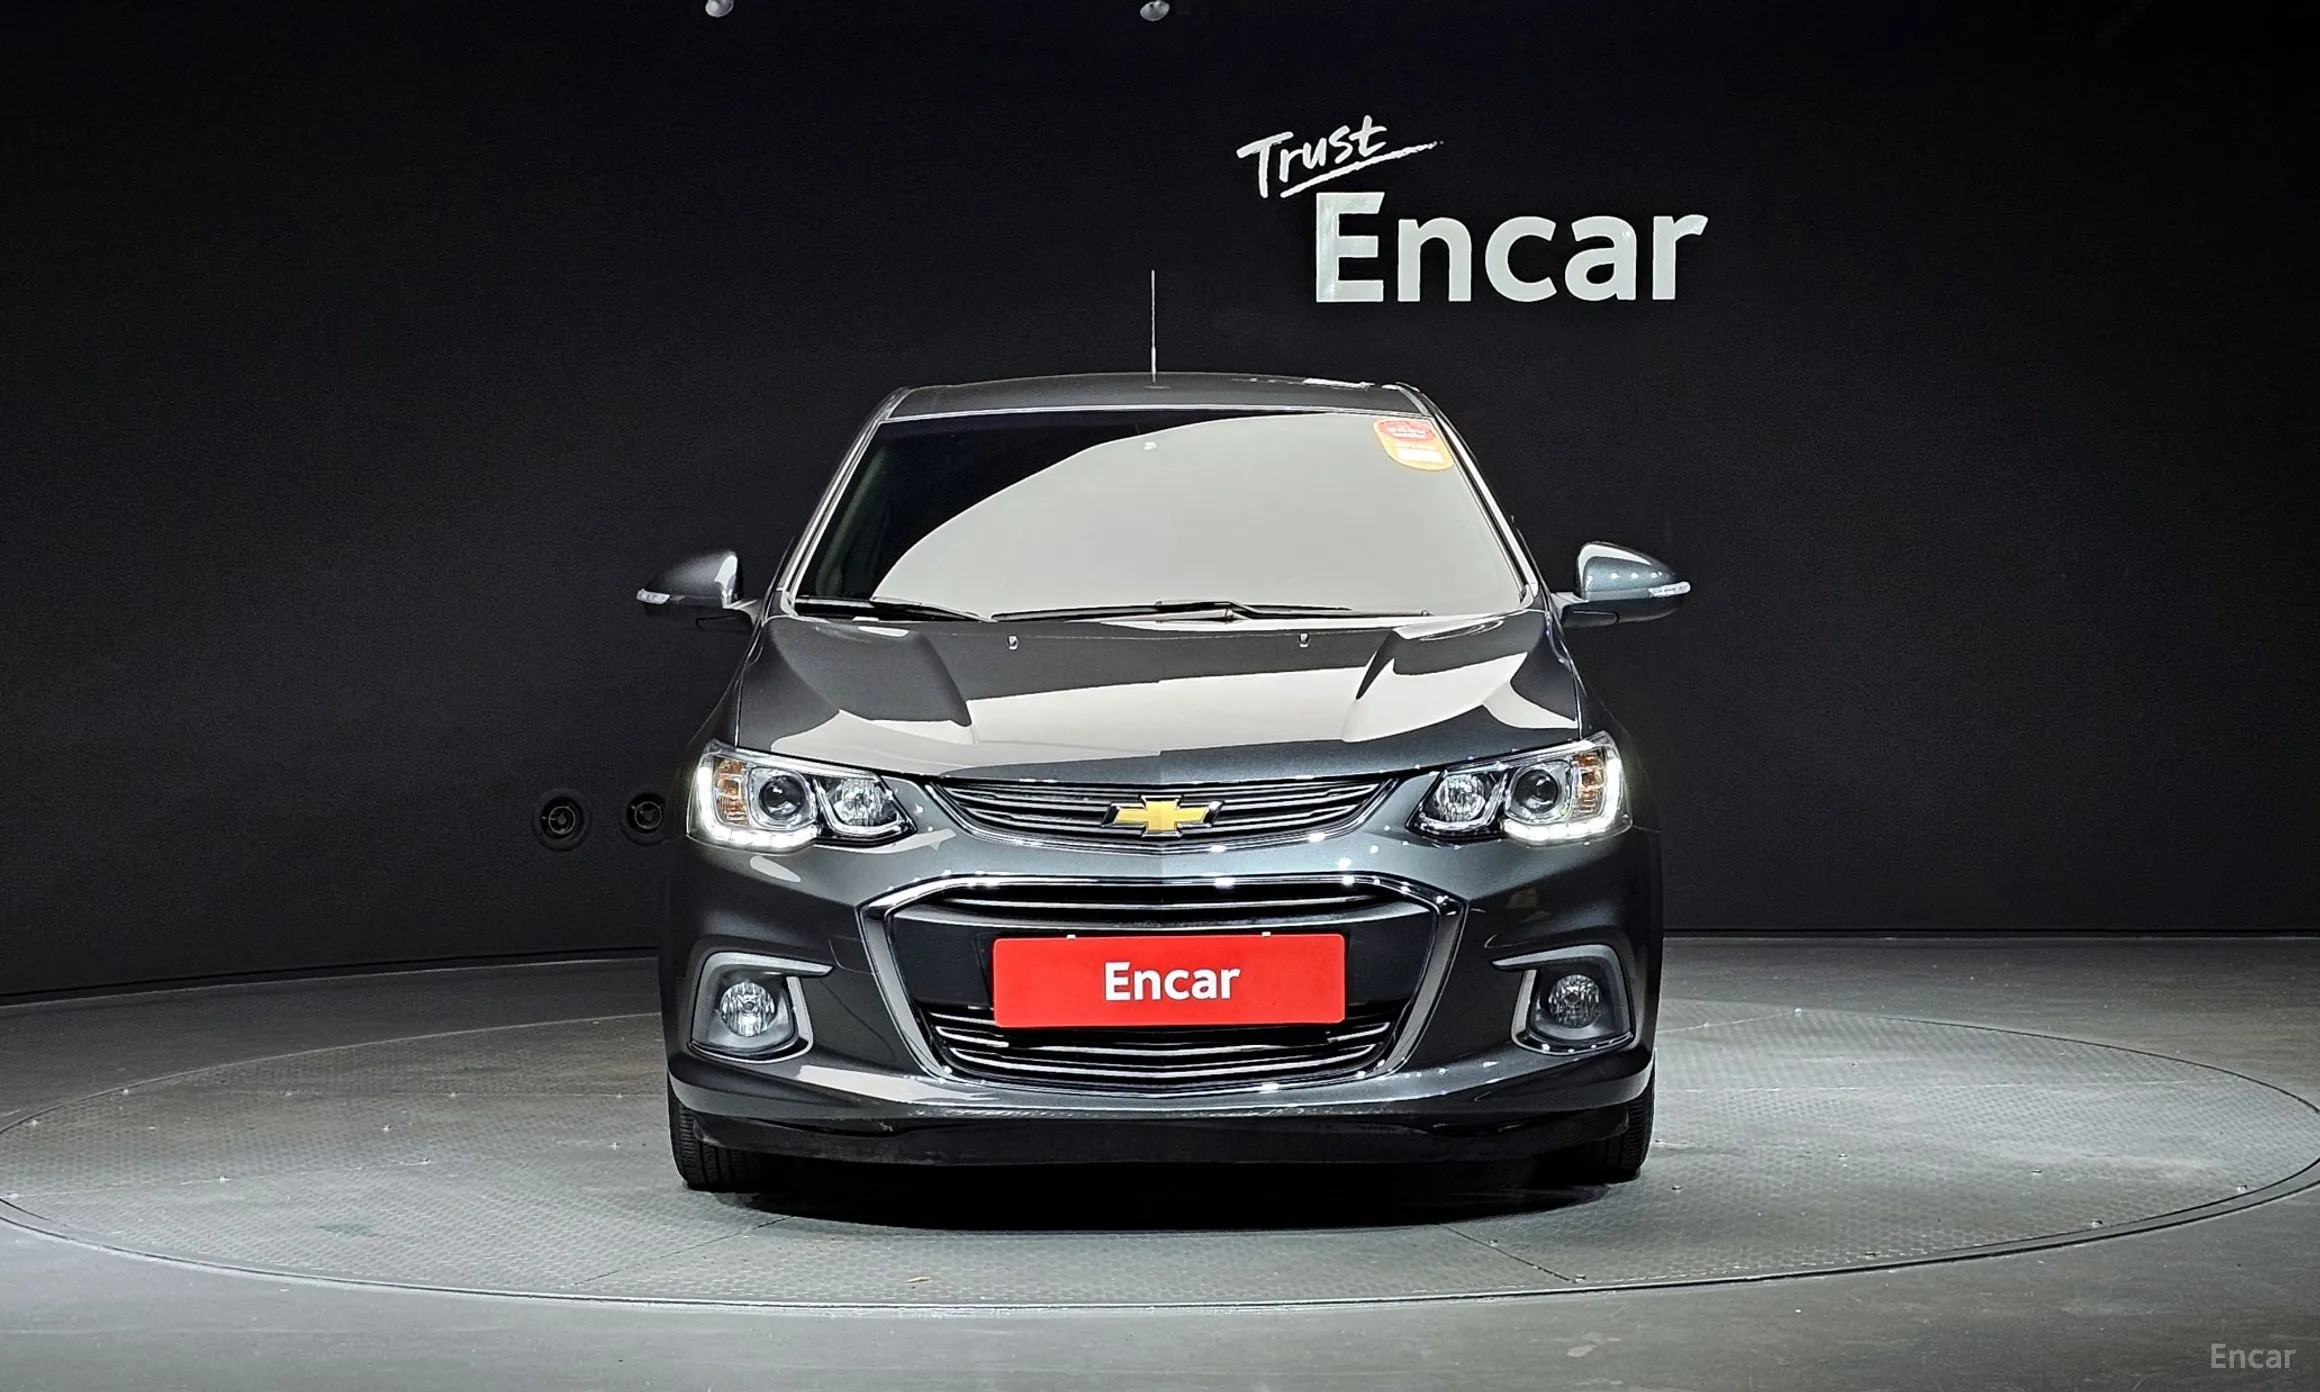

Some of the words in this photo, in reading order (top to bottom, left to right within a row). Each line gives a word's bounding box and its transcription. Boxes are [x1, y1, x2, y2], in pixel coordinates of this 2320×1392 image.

[1236, 114, 1388, 199] Trust
[1315, 191, 1709, 303] Encar
[1104, 961, 1241, 1002] Encar
